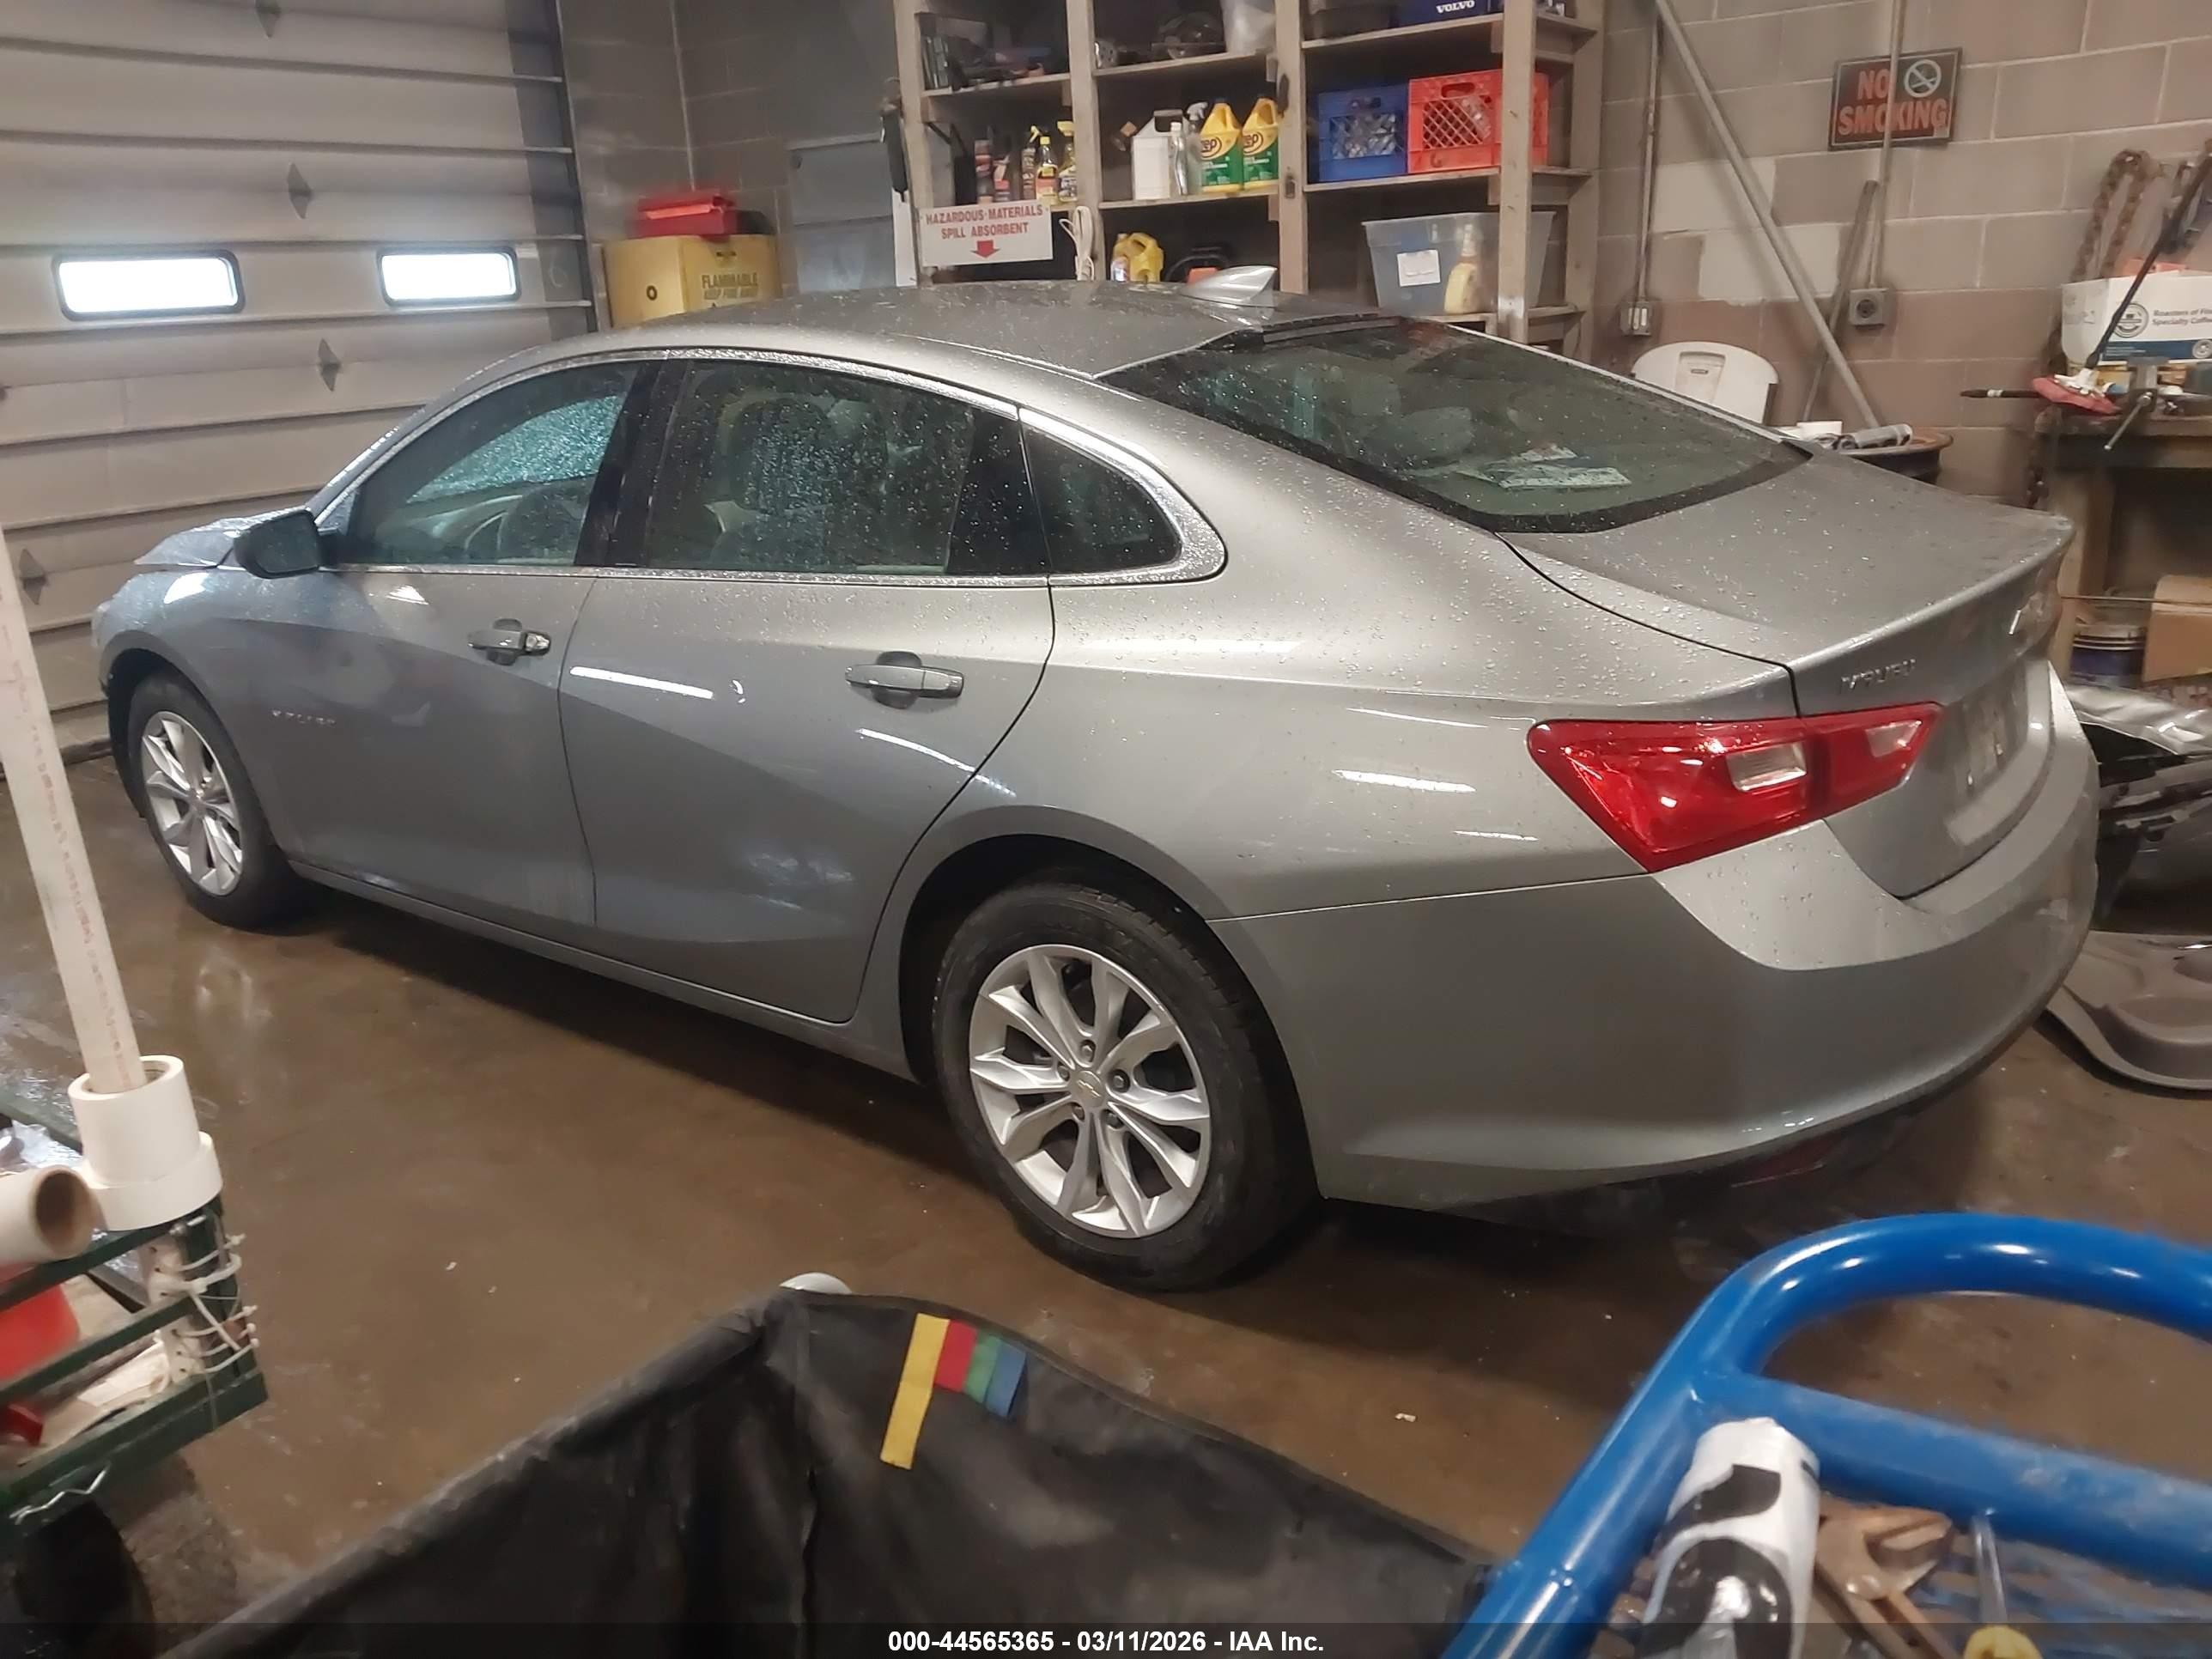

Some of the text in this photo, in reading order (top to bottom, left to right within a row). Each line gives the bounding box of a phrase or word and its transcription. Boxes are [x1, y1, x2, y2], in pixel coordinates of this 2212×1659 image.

[1436, 0, 1475, 14] VOLVO
[1857, 68, 1891, 100] NO
[1838, 98, 1948, 136] SMOKING
[926, 204, 1043, 225] HAZARDOUS MATERIALS
[941, 222, 1029, 240] SPILL ABSORBENT
